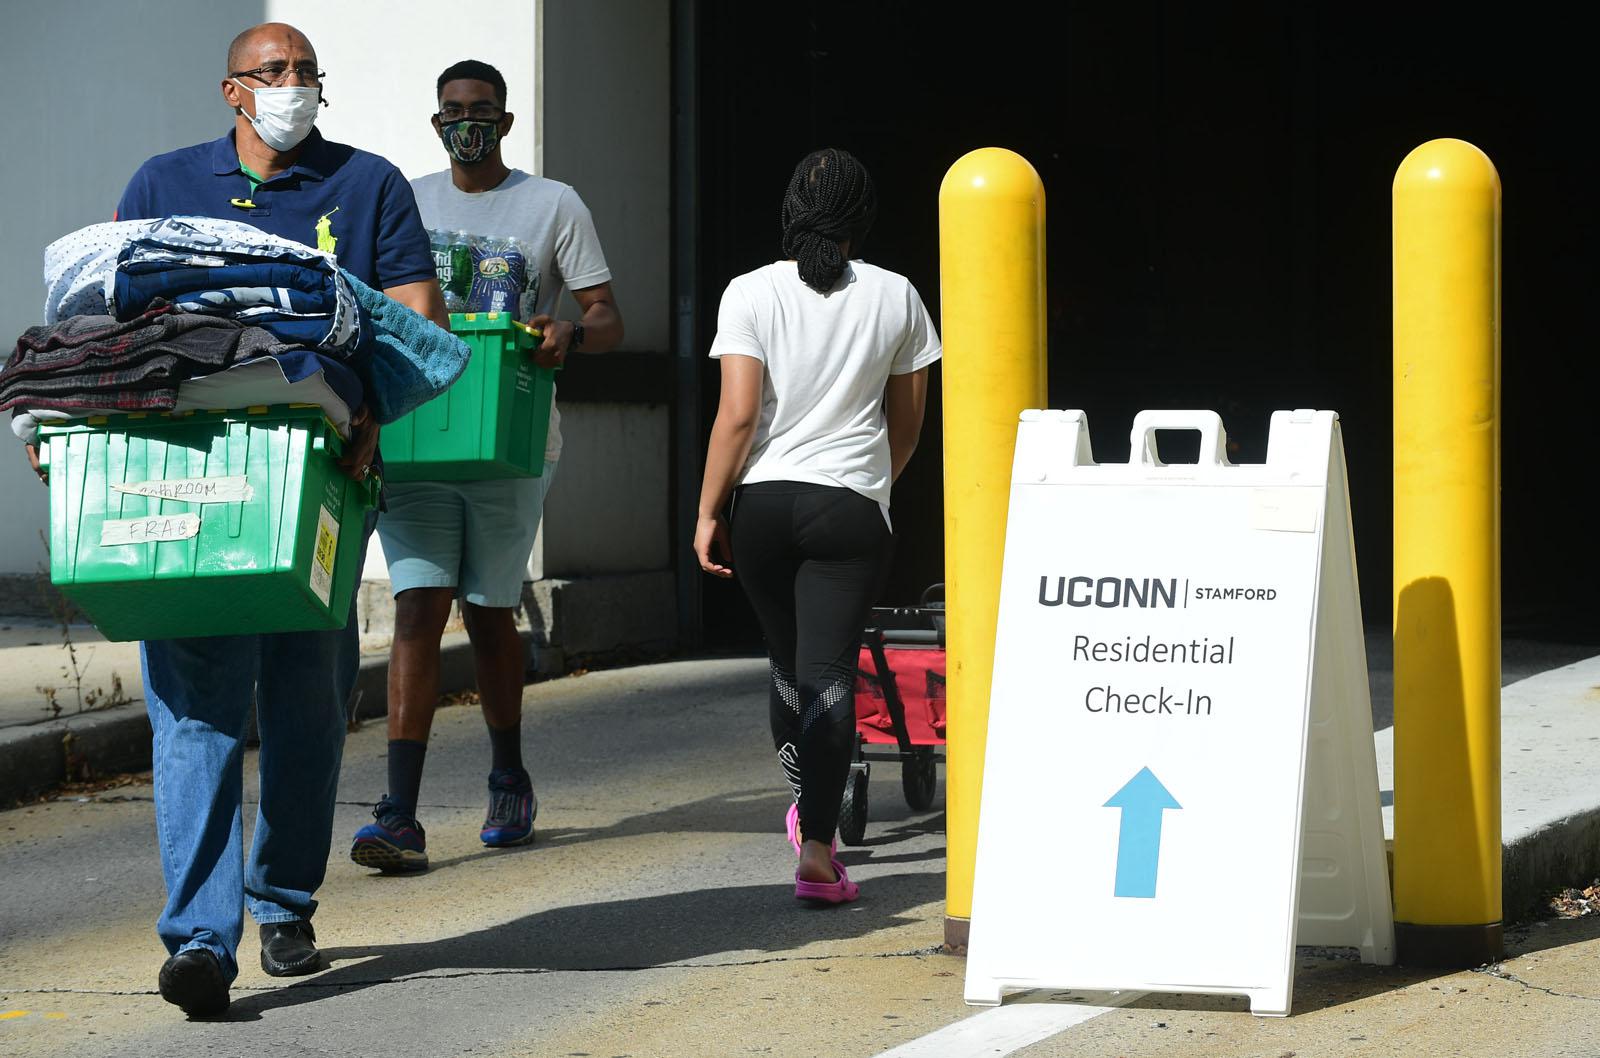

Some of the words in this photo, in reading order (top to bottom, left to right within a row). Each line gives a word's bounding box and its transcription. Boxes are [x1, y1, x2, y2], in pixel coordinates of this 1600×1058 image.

[1038, 575, 1178, 609] UCONN
[1195, 587, 1277, 601] STAMFORD
[1073, 635, 1234, 665] Residential
[1085, 686, 1212, 716] Check-In
